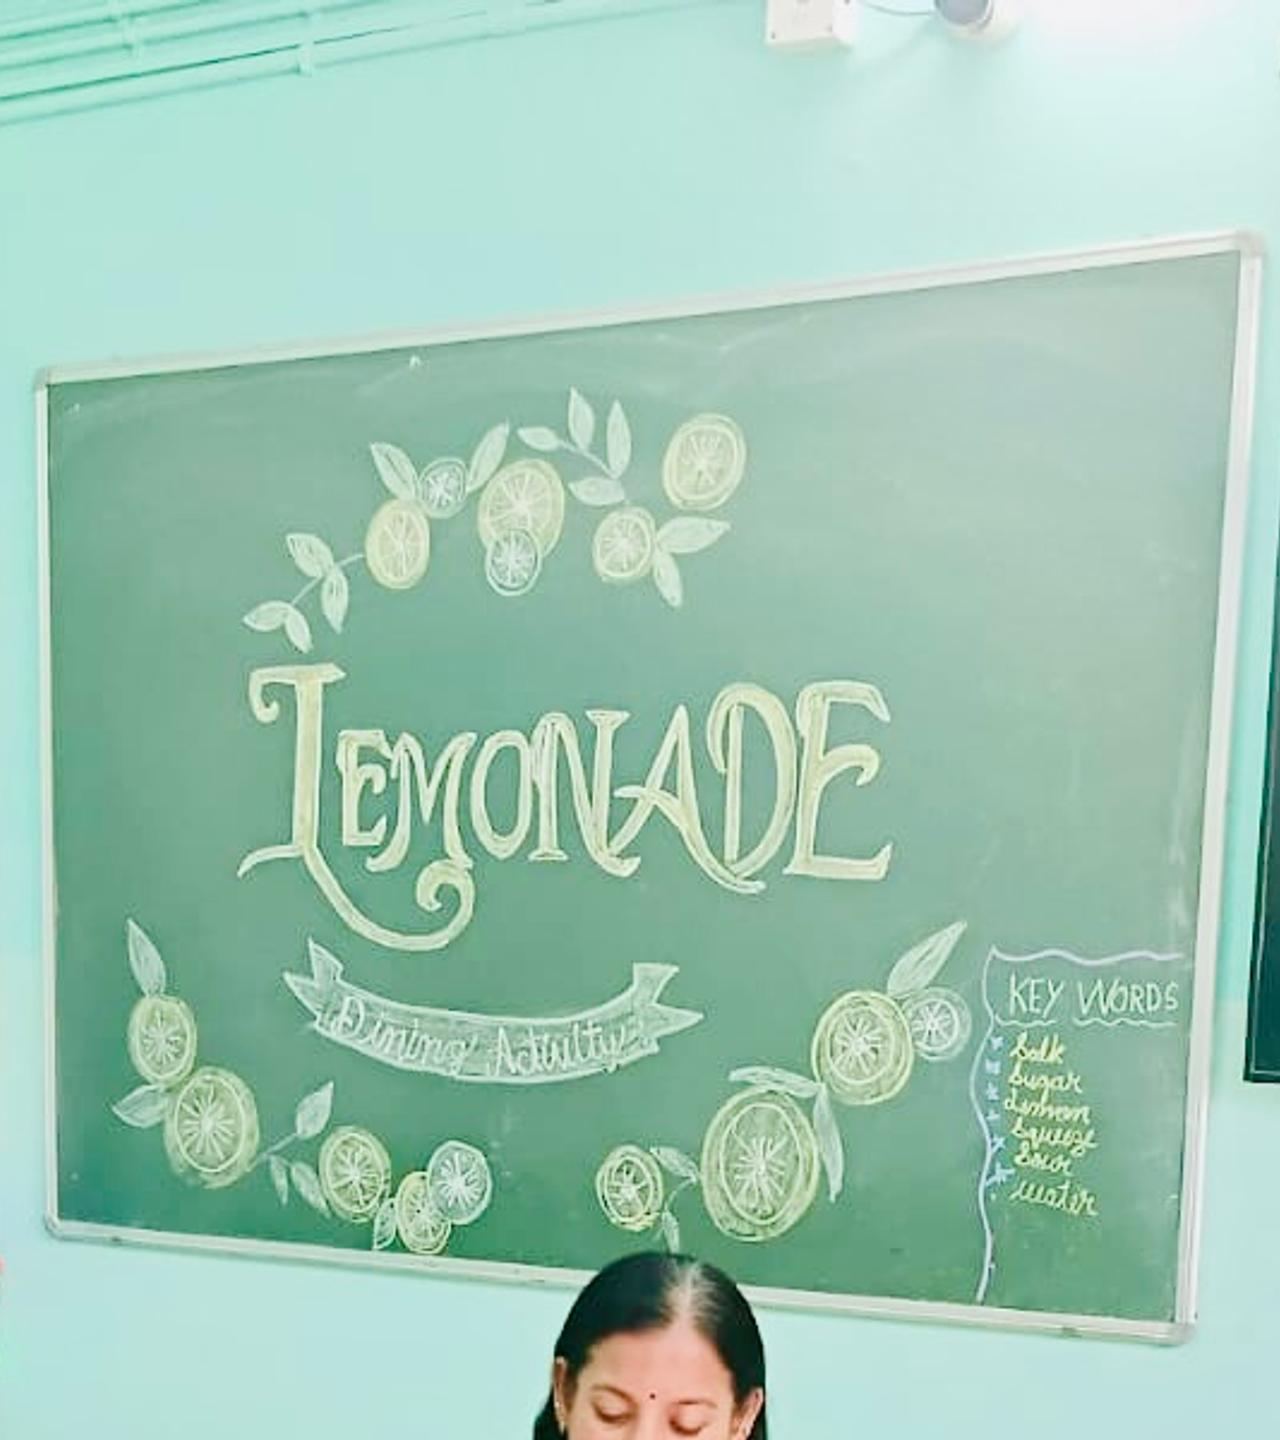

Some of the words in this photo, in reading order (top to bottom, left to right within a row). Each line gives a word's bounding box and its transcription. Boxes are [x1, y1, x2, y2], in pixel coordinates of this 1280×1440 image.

[237, 662, 893, 952] LEMONADE
[332, 995, 477, 1073] Dining
[487, 1022, 625, 1076] Activity
[1009, 974, 1065, 1017] KEY
[1076, 977, 1179, 1015] WORDS
